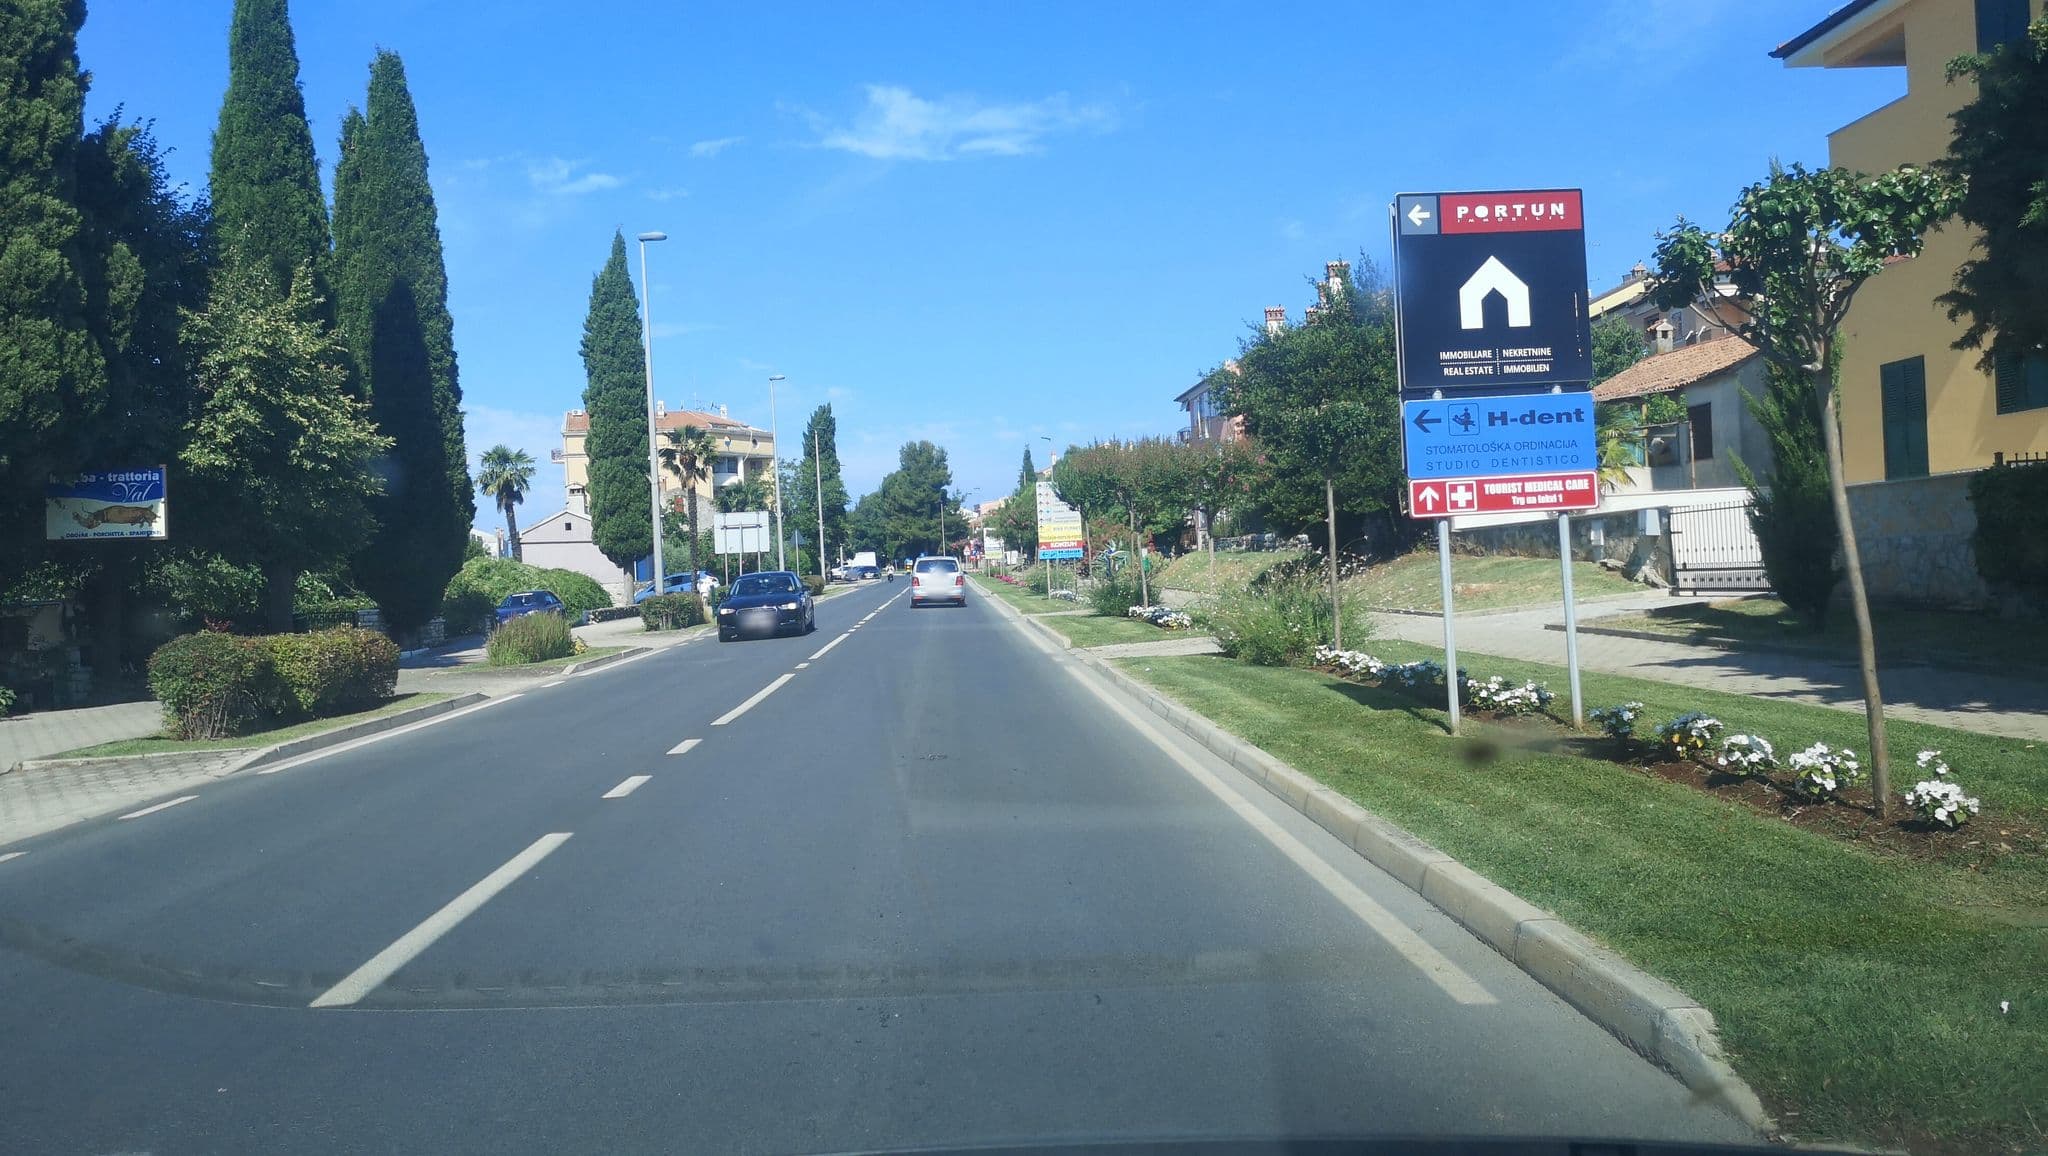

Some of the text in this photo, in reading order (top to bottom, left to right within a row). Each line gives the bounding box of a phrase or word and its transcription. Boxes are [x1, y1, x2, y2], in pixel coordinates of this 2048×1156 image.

[1457, 203, 1564, 218] PORTUN
[1440, 348, 1552, 360] IMMOBILIARE NEKRETNINE
[1443, 364, 1550, 376] REAL ESTATE IMMOBILIEN
[1487, 408, 1585, 427] H-dent
[1425, 440, 1578, 455] STOMATOLOŠKA ORDINACIJA
[1425, 454, 1579, 471] STUDIO DENTISTICO
[108, 470, 159, 482] trattoria
[1483, 478, 1590, 495] TOURIST MEDICAL CARE
[1511, 495, 1526, 506] Trg
